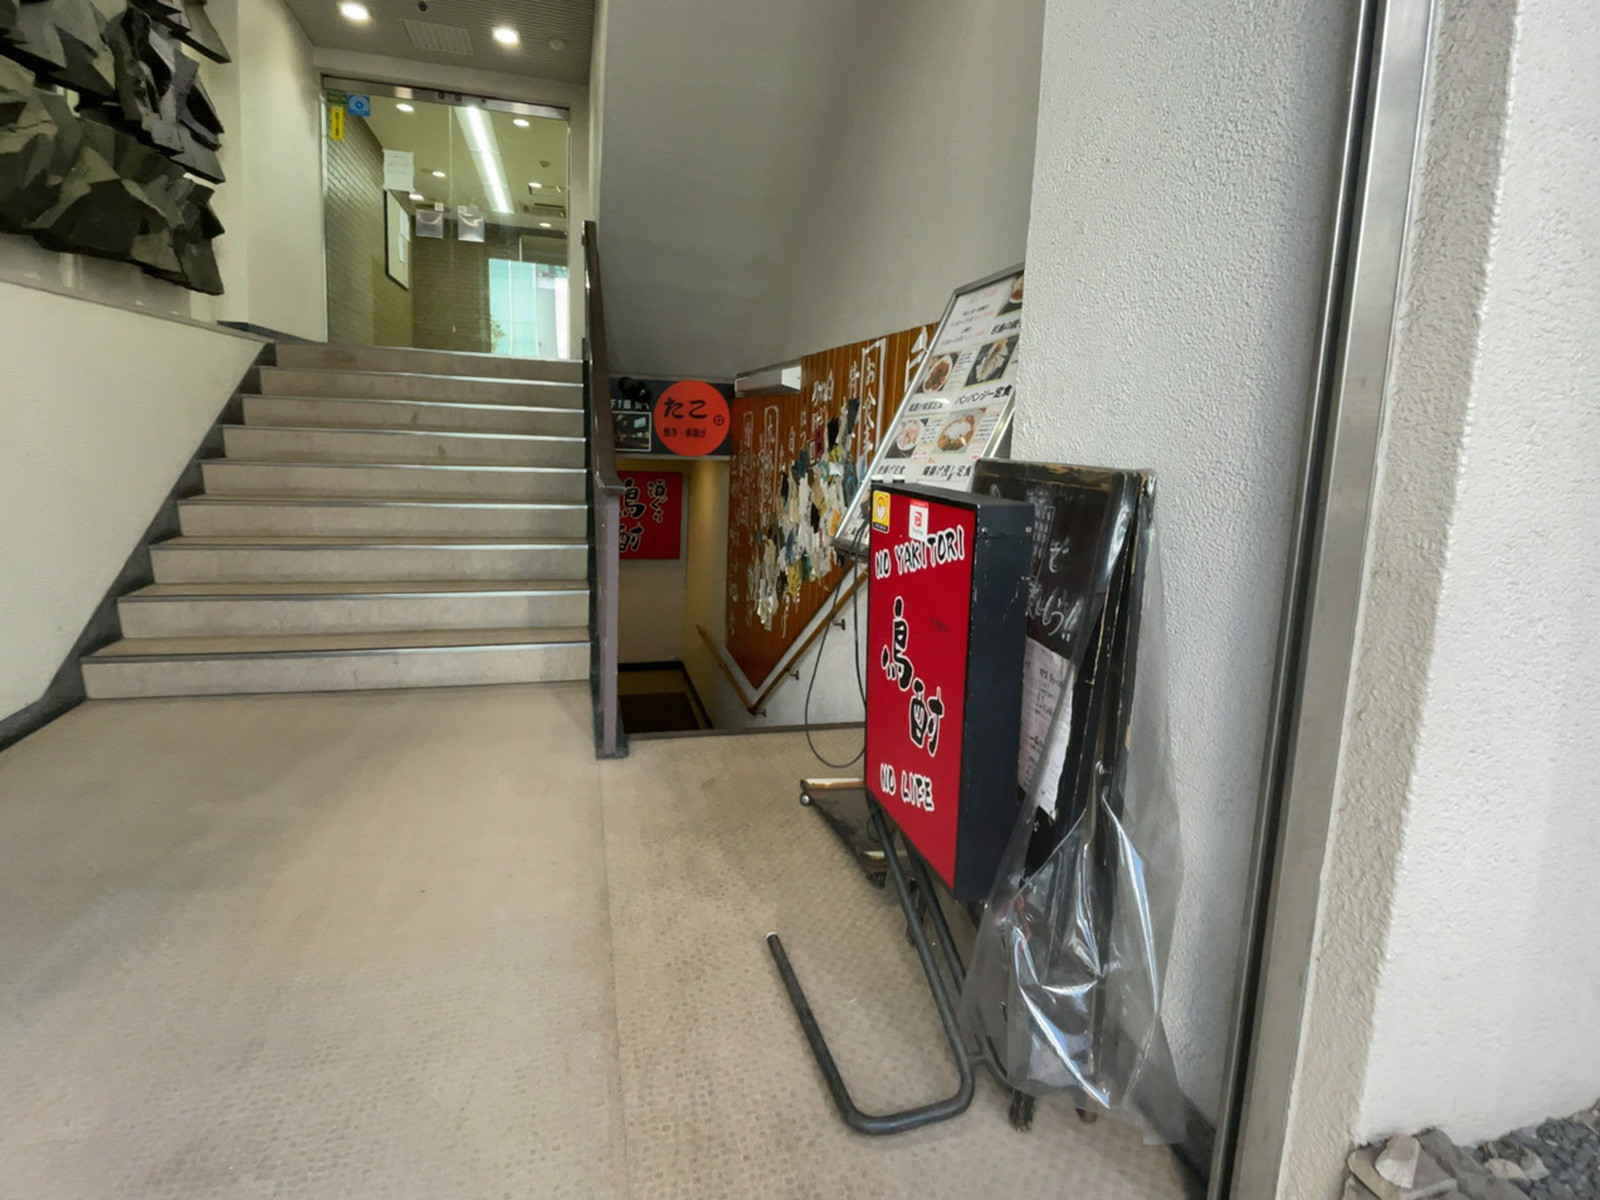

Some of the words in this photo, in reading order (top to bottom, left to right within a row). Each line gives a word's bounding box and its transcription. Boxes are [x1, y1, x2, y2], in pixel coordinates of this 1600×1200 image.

[664, 397, 708, 419] たこ
[875, 549, 891, 580] NO
[880, 763, 896, 796] NO
[901, 770, 934, 811] LIFE
